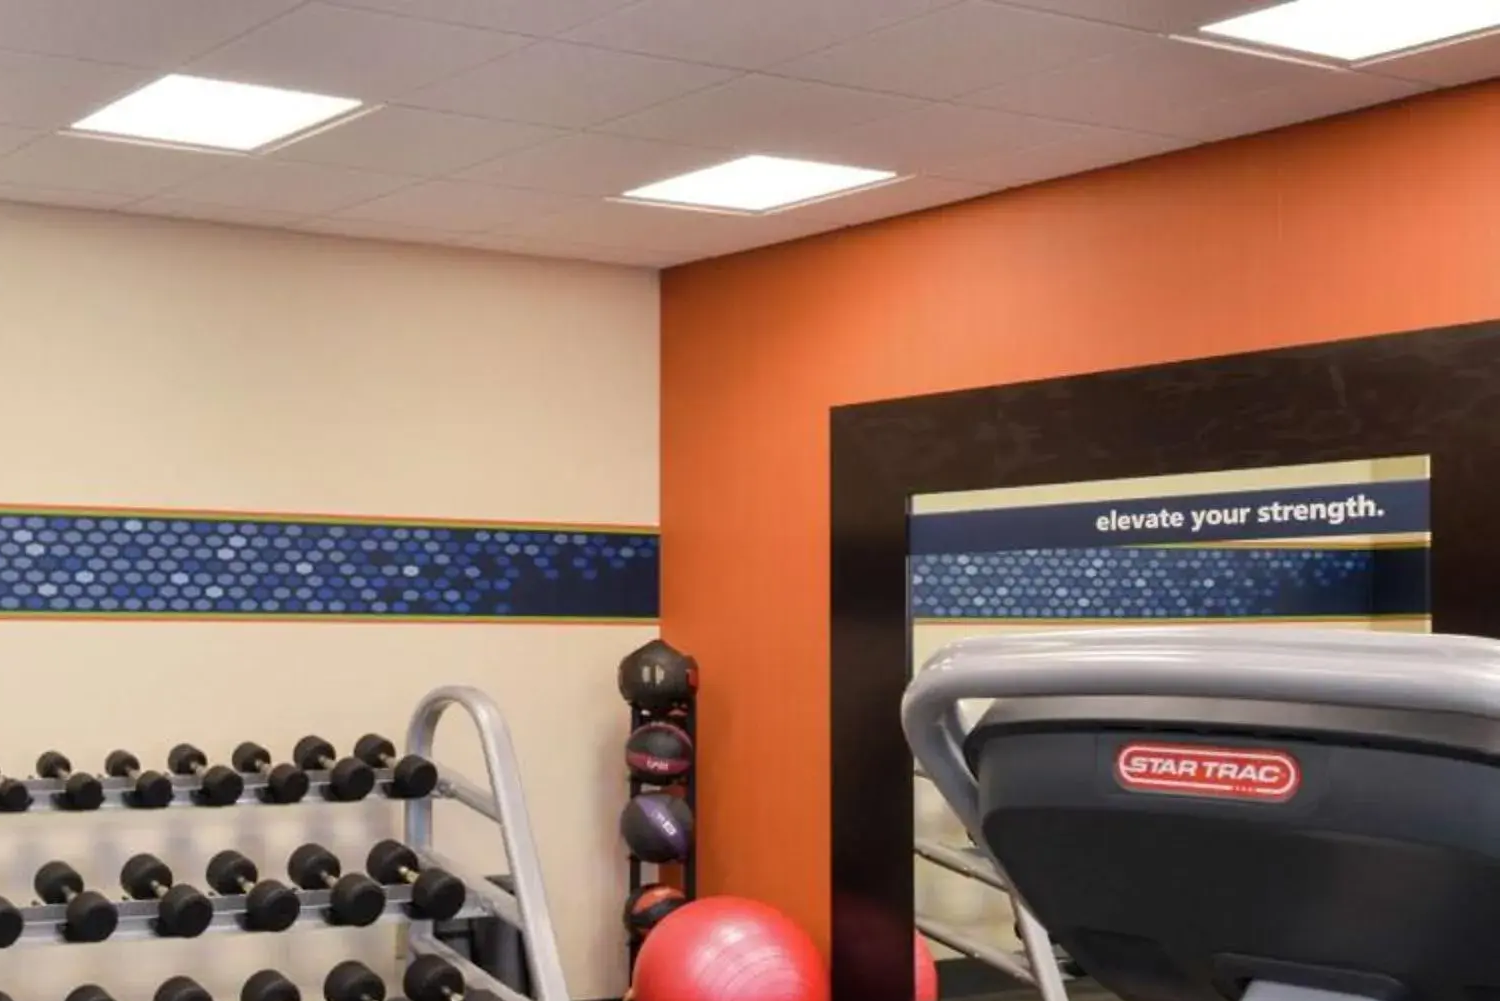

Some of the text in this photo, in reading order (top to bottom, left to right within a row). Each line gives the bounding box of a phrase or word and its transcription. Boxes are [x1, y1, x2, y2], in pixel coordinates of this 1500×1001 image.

[1095, 494, 1386, 532] elevate your strength.
[1126, 756, 1283, 784] STAR TRAC
